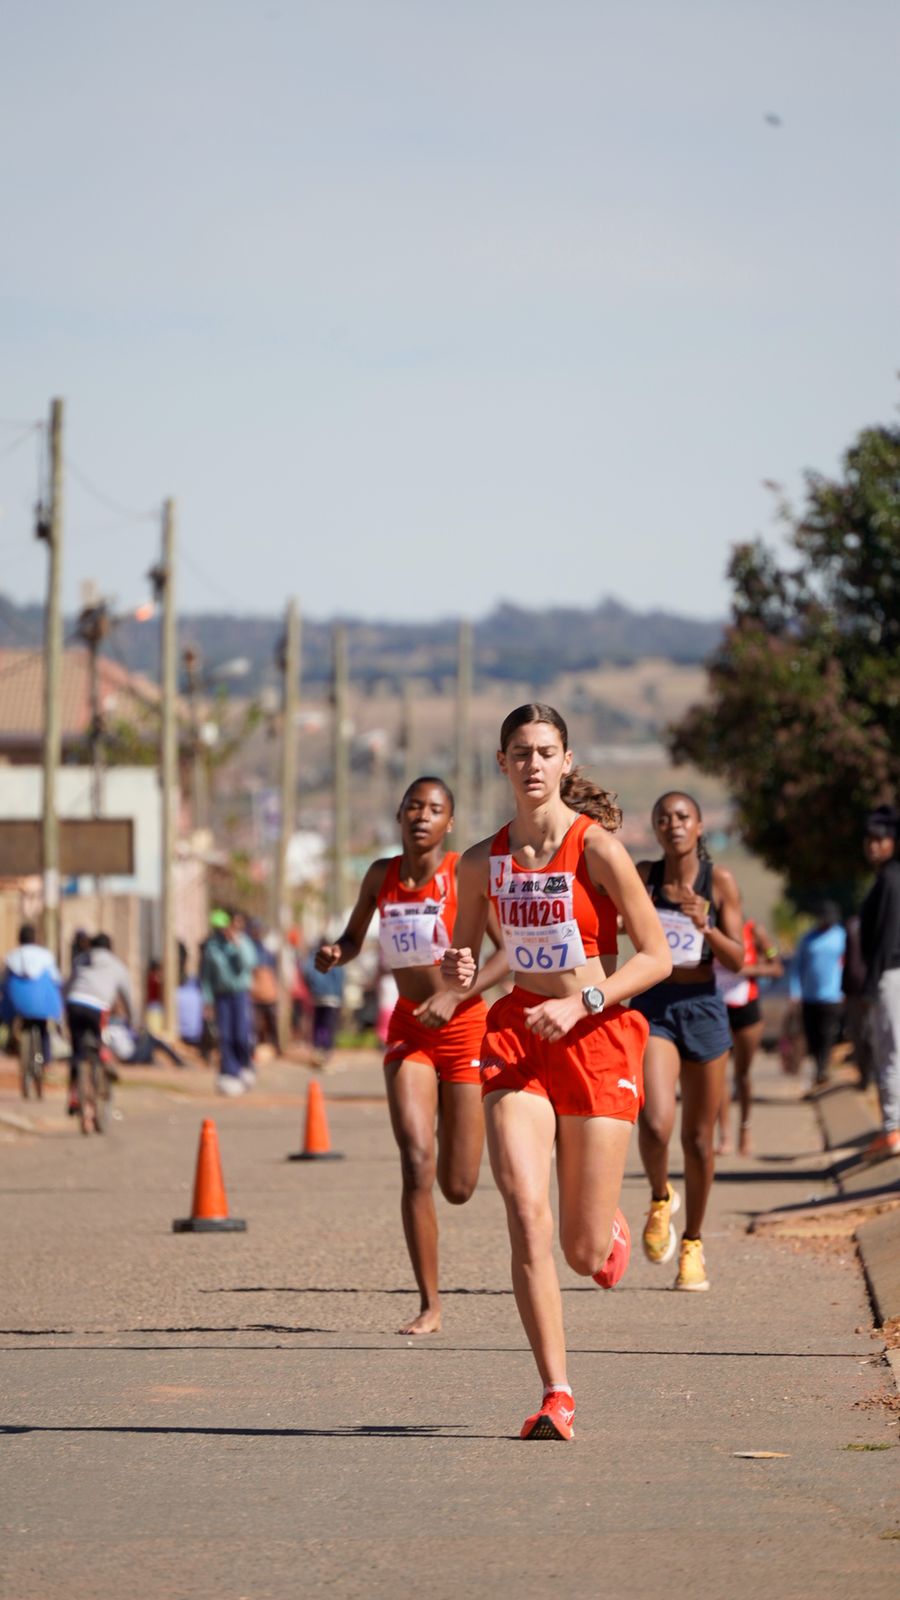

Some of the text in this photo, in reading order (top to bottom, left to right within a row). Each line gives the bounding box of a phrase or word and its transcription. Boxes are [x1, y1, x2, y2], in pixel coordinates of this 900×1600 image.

[392, 931, 418, 953] 151
[666, 931, 695, 950] 02
[515, 944, 569, 969] 067
